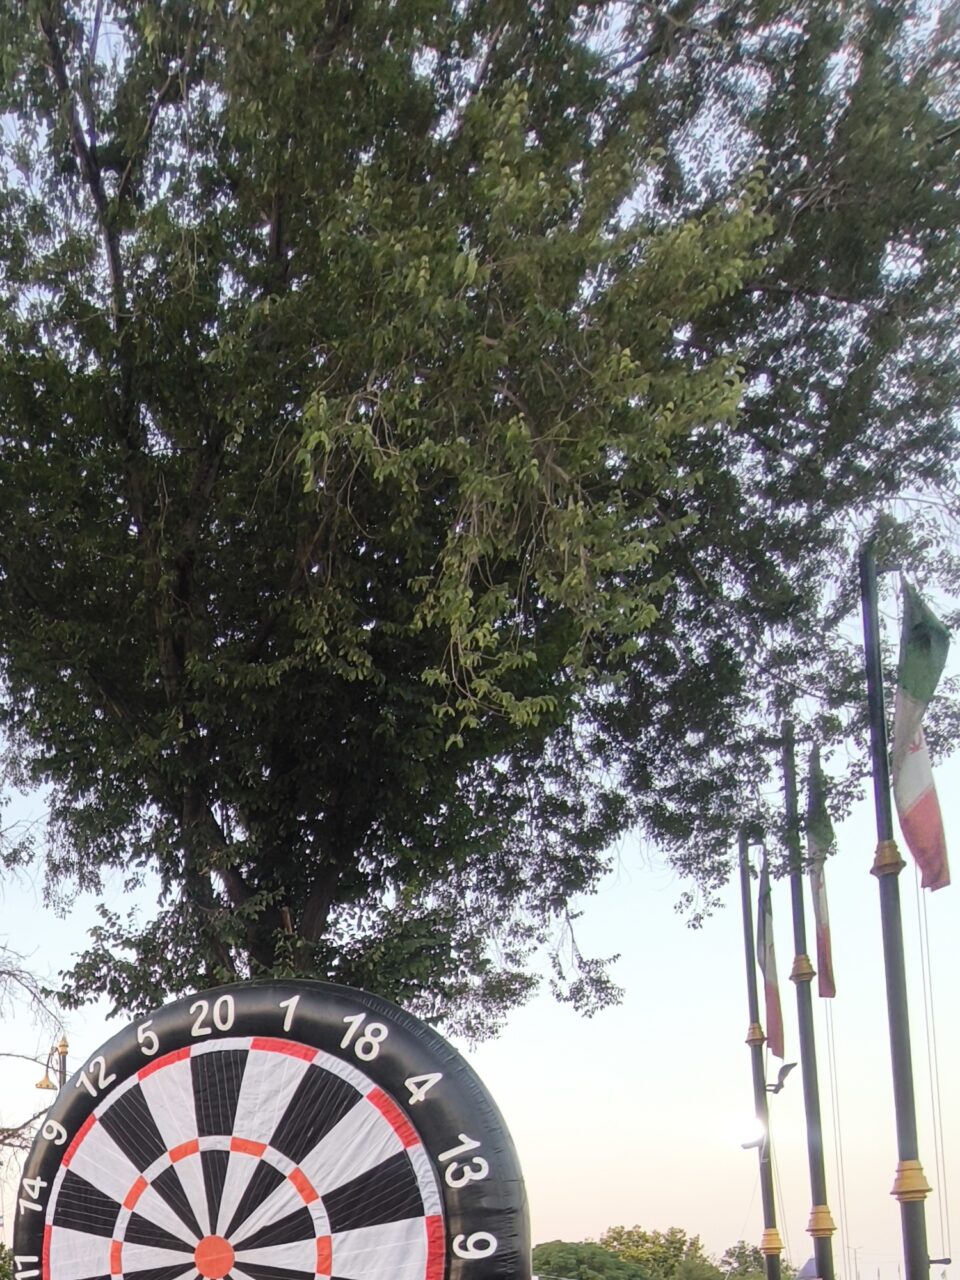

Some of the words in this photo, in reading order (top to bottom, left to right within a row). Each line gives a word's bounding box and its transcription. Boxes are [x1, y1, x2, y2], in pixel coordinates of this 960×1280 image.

[189, 994, 235, 1037] 20
[279, 994, 301, 1032] 1
[137, 1019, 160, 1056] 5
[340, 1012, 389, 1062] 18
[75, 1055, 117, 1098] 12
[404, 1072, 443, 1105] 4
[42, 1119, 67, 1146] 9
[438, 1133, 490, 1189] 13
[19, 1176, 48, 1215] 14
